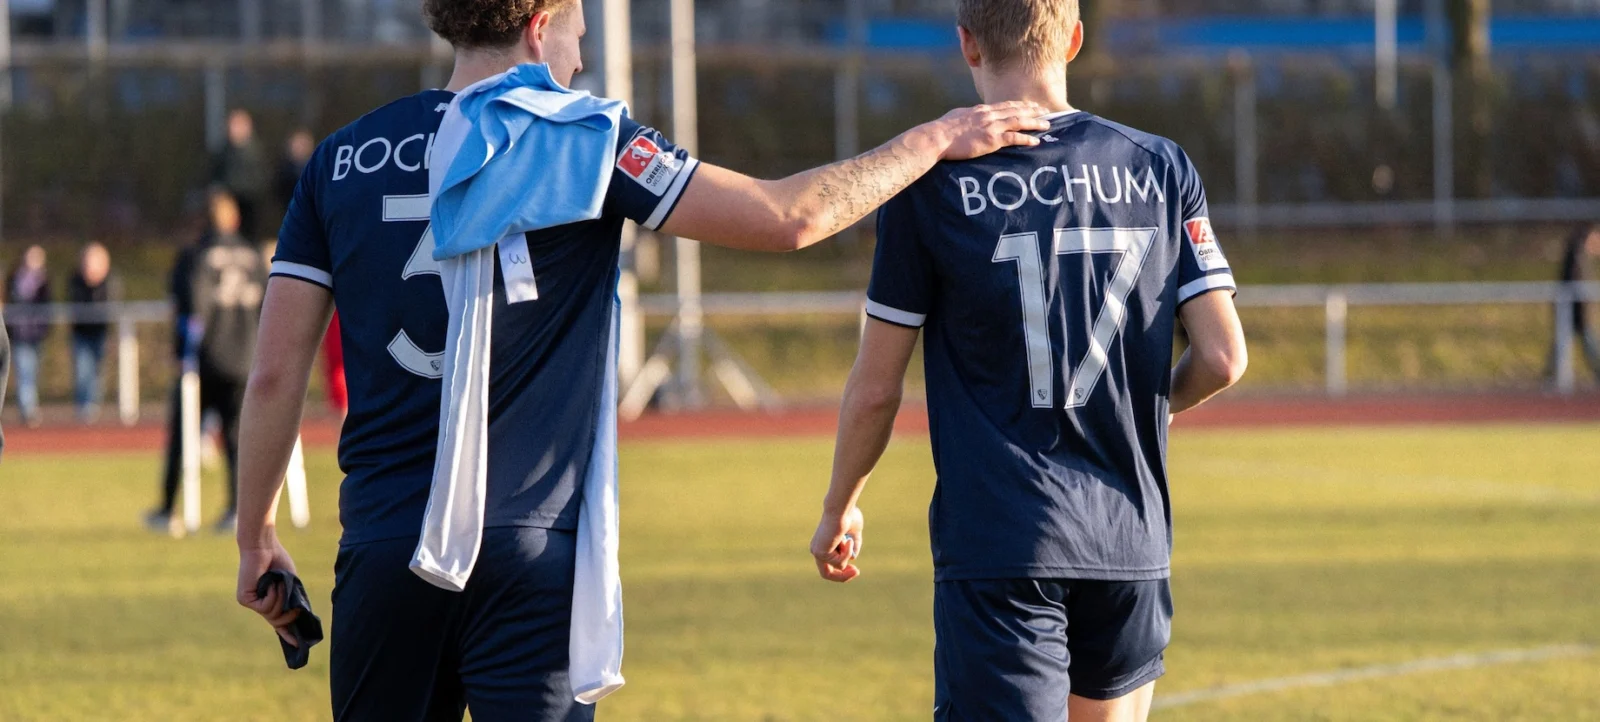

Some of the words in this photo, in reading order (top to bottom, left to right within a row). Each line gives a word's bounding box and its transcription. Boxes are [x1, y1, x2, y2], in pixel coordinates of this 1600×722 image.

[332, 133, 435, 181] BOC
[959, 164, 1164, 216] BOCHUM
[991, 227, 1158, 409] 17
